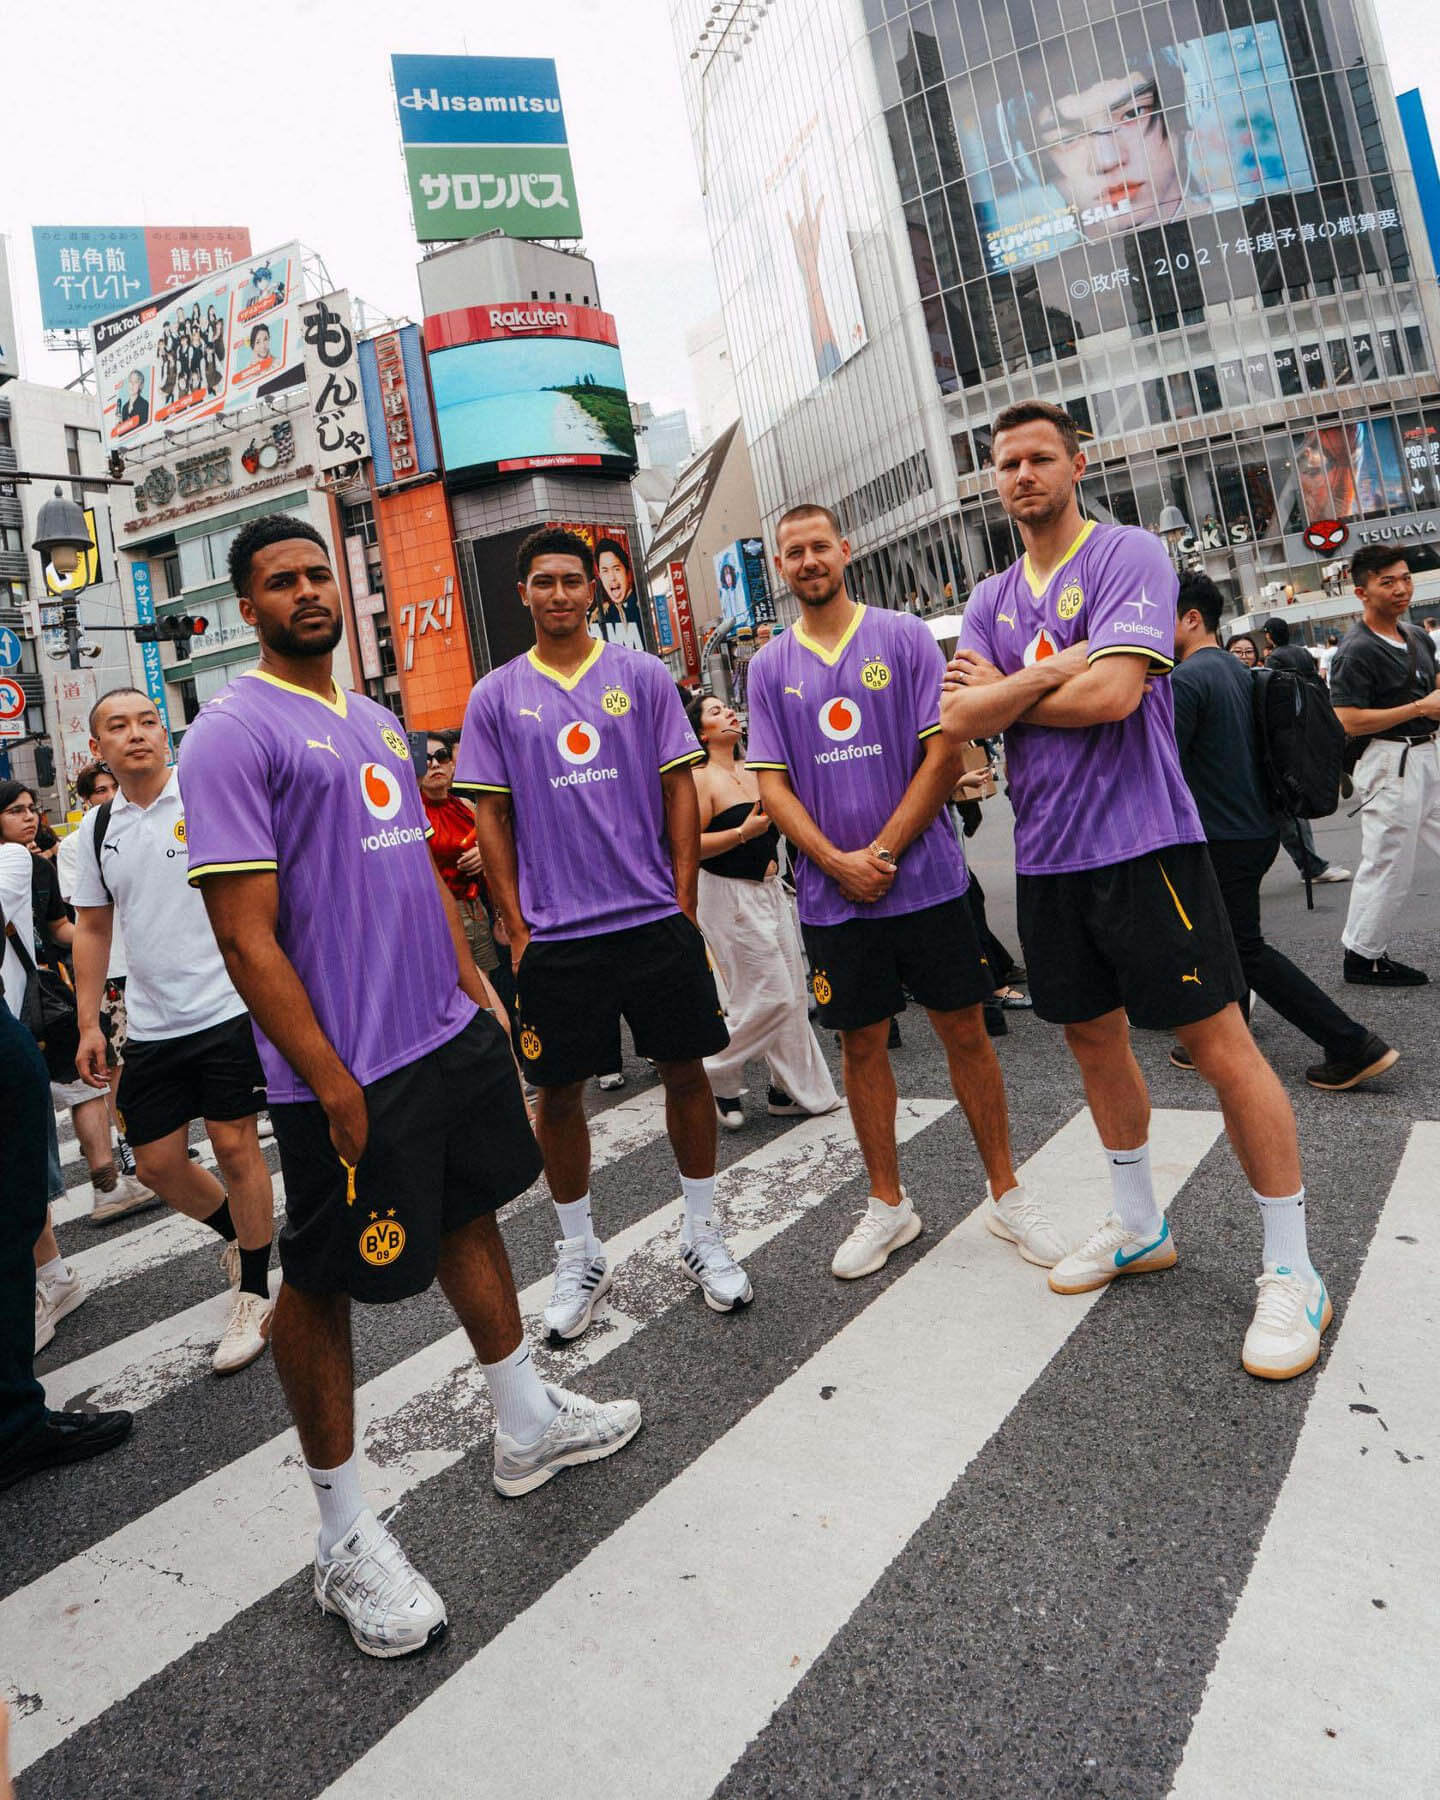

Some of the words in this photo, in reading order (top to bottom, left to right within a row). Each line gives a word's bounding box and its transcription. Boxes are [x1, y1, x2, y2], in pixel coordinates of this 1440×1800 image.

[400, 87, 561, 113] Hisamitsu
[418, 173, 569, 210] サロンパス
[1080, 198, 1132, 226] SALE
[107, 314, 141, 337] TikTok
[489, 308, 569, 329] Rakuten
[303, 301, 366, 455] もんじゃ
[1359, 521, 1438, 544] TSUTAYA
[672, 570, 690, 625] カラオケ
[1060, 592, 1080, 613] BVB
[400, 576, 454, 672] クスリ
[1113, 621, 1165, 640] Polestar
[865, 665, 887, 682] BVB
[605, 693, 627, 709] BVB
[385, 731, 406, 752] BVB
[813, 743, 883, 765] vodafone
[550, 767, 618, 789] vodafone
[360, 826, 425, 853] vodafone
[366, 1224, 400, 1253] BVB
[376, 1250, 390, 1260] 09
